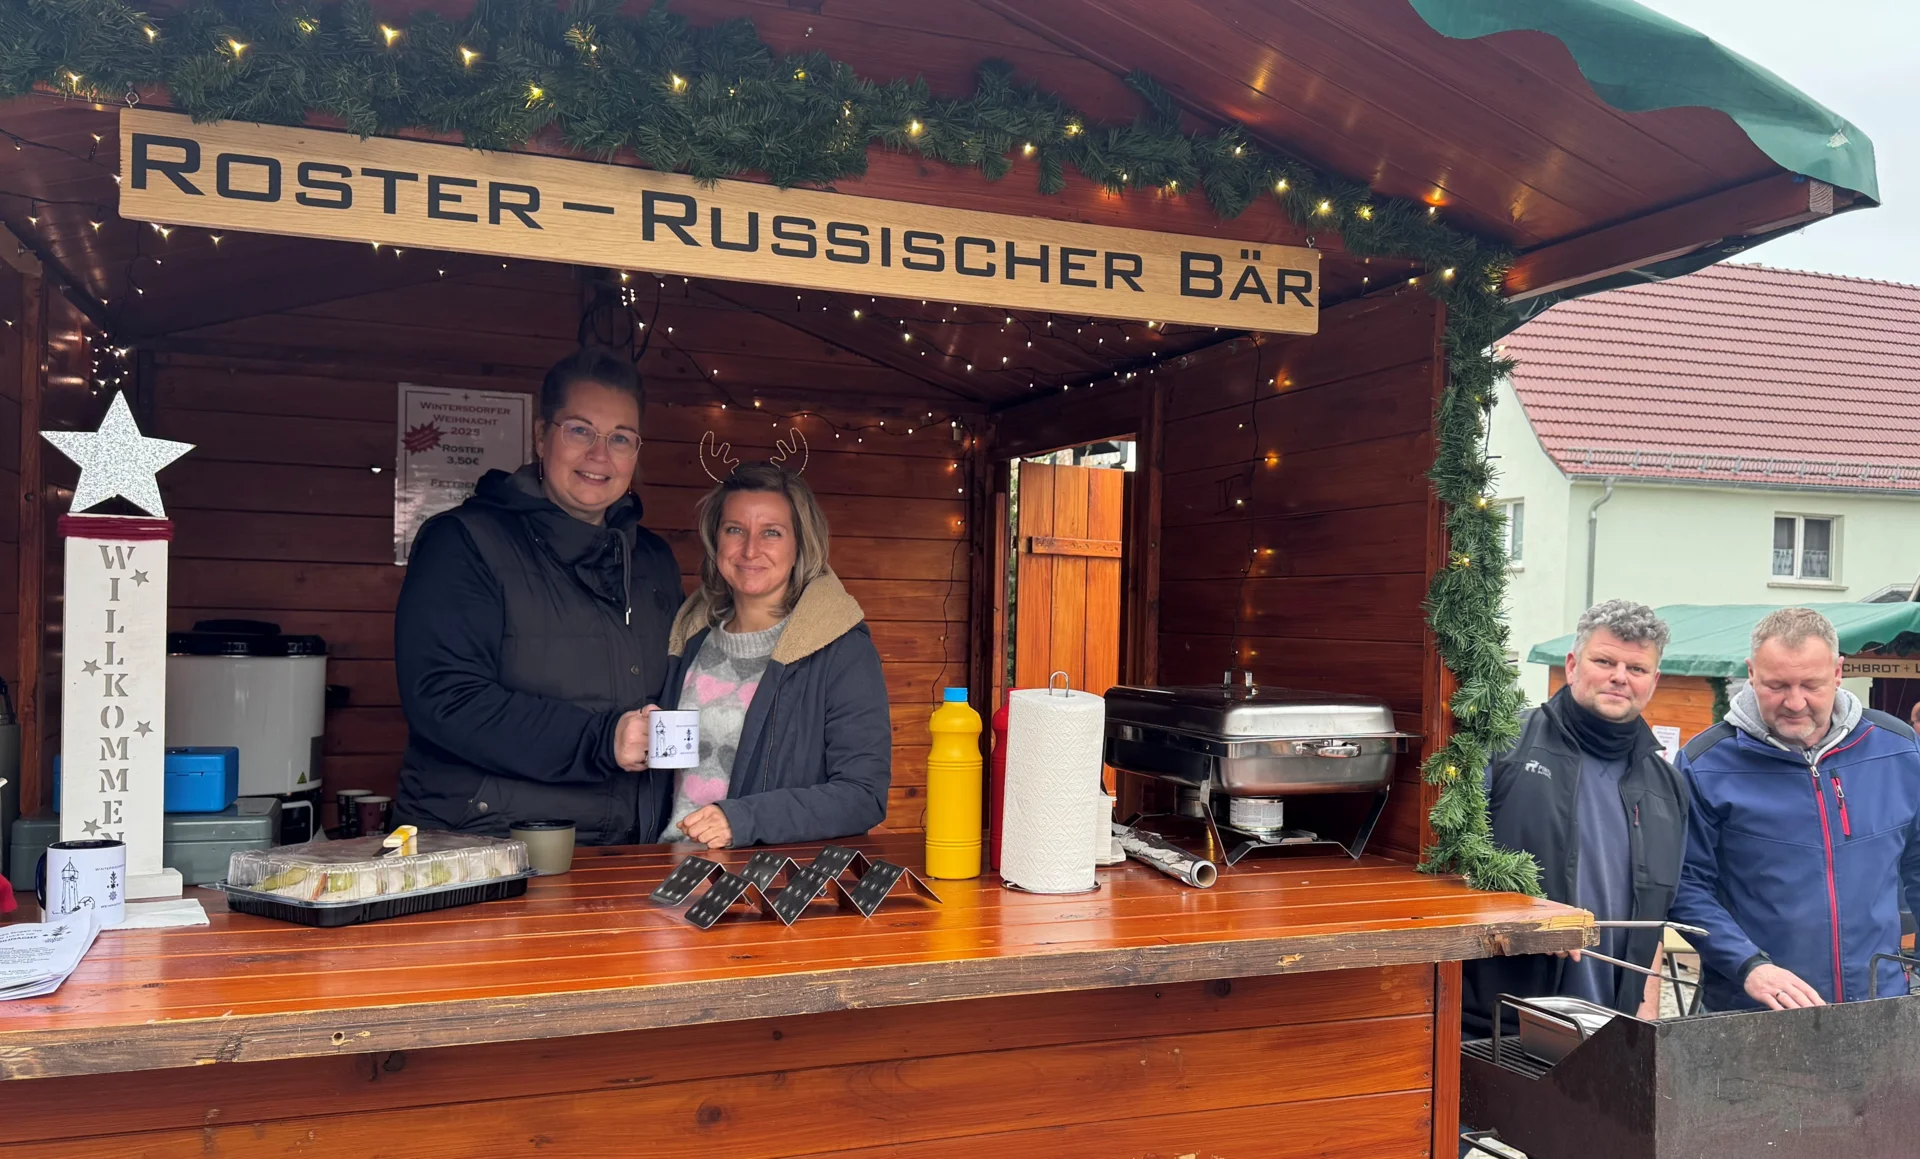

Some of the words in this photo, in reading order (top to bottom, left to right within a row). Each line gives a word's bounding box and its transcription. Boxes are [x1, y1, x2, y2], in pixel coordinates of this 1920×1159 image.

[132, 132, 545, 231] ROSTER
[640, 188, 1146, 293] RUSSISCHER
[1179, 248, 1316, 308] BÄR
[420, 401, 511, 416] WINTERSDORFER
[433, 414, 498, 426] WEIHNACHT
[451, 427, 481, 437] 2025
[442, 444, 485, 455] ROSTER
[446, 456, 480, 466] 3,50€
